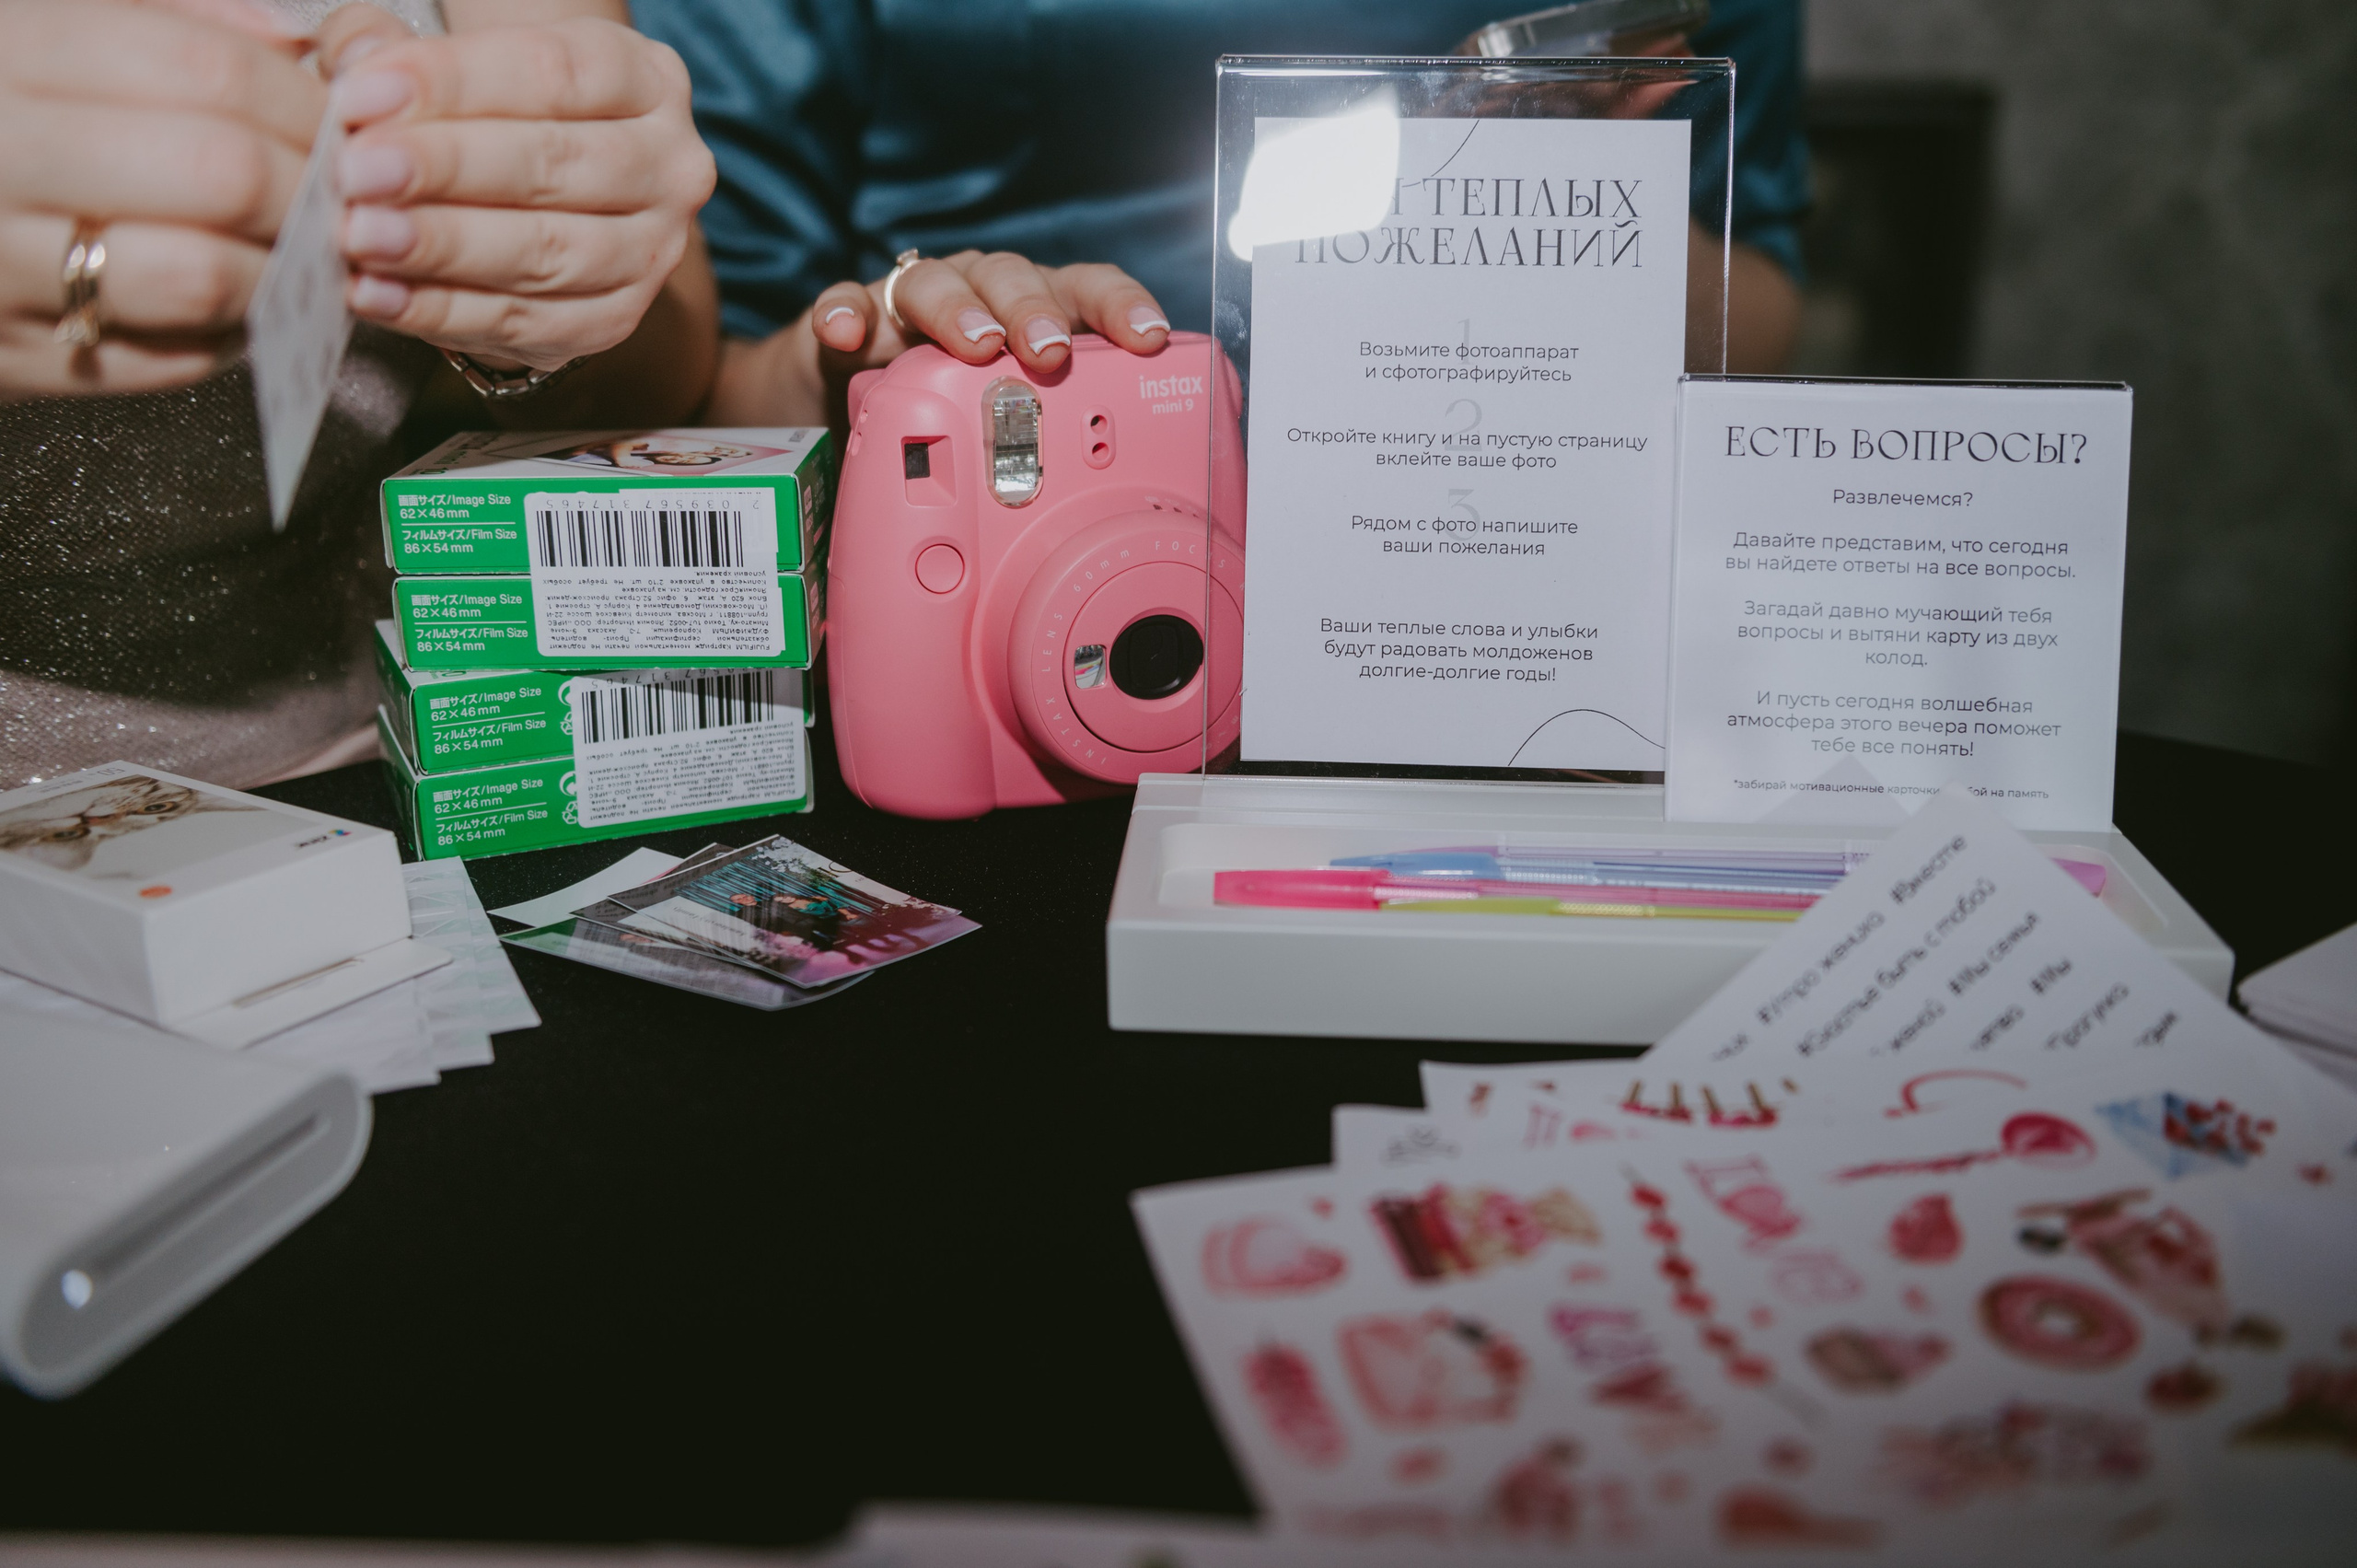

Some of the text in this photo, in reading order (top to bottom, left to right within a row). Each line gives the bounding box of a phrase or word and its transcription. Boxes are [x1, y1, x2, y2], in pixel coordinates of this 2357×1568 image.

[1422, 178, 1643, 222] ТЕПЛЫХ
[1360, 342, 1579, 362] Возьмите фотоаппарат
[1365, 364, 1572, 385] и сфотографируйтесь
[1139, 376, 1203, 399] instax
[1152, 399, 1194, 414] mini 9
[1287, 427, 1648, 452] Откройте книгу и на пустую страницу
[1727, 426, 2087, 464] ЕСТЬ ВОПРОСЫ?
[1376, 451, 1557, 470] вклейте ваше фото
[487, 494, 511, 505] Size
[546, 499, 630, 509] 317465
[751, 499, 760, 509] 2
[1833, 489, 1973, 506] Развлечемся?
[494, 528, 517, 540] Size
[1352, 515, 1578, 535] Рядом с фото напишите
[1383, 540, 1545, 555] ваши пожелания
[1733, 531, 2069, 557] Давайте представим, что сегодня
[1725, 555, 2076, 580] вы найдете ответы на все вопросы.
[499, 593, 523, 605] Size
[1744, 599, 2052, 623] Загадай давно мучающий тебя
[506, 627, 528, 638] Size
[1320, 618, 1597, 641] Ваши теплые слова и улыбки
[1737, 625, 2059, 650] вопросы и вытяни карту из двух
[1042, 540, 1225, 765] INSTAX LENS 60mm FOCS
[1324, 638, 1593, 661] будут радовать молдоженов
[1865, 652, 1928, 668] колод.
[1359, 665, 1556, 683] долгие-долгие годы!
[518, 687, 542, 698] Size
[1757, 691, 2033, 714] И пусть сегодня волшебная
[525, 719, 547, 730] Size
[1726, 713, 2062, 737] атмосфера этого вечера поможет
[1811, 737, 1974, 757] тебе все понять!
[520, 778, 543, 790] Size
[1790, 783, 1885, 795] мотивационные
[1887, 785, 1941, 796] карточки
[1991, 789, 2004, 798] на
[2007, 789, 2049, 799] память
[527, 809, 548, 820] Size
